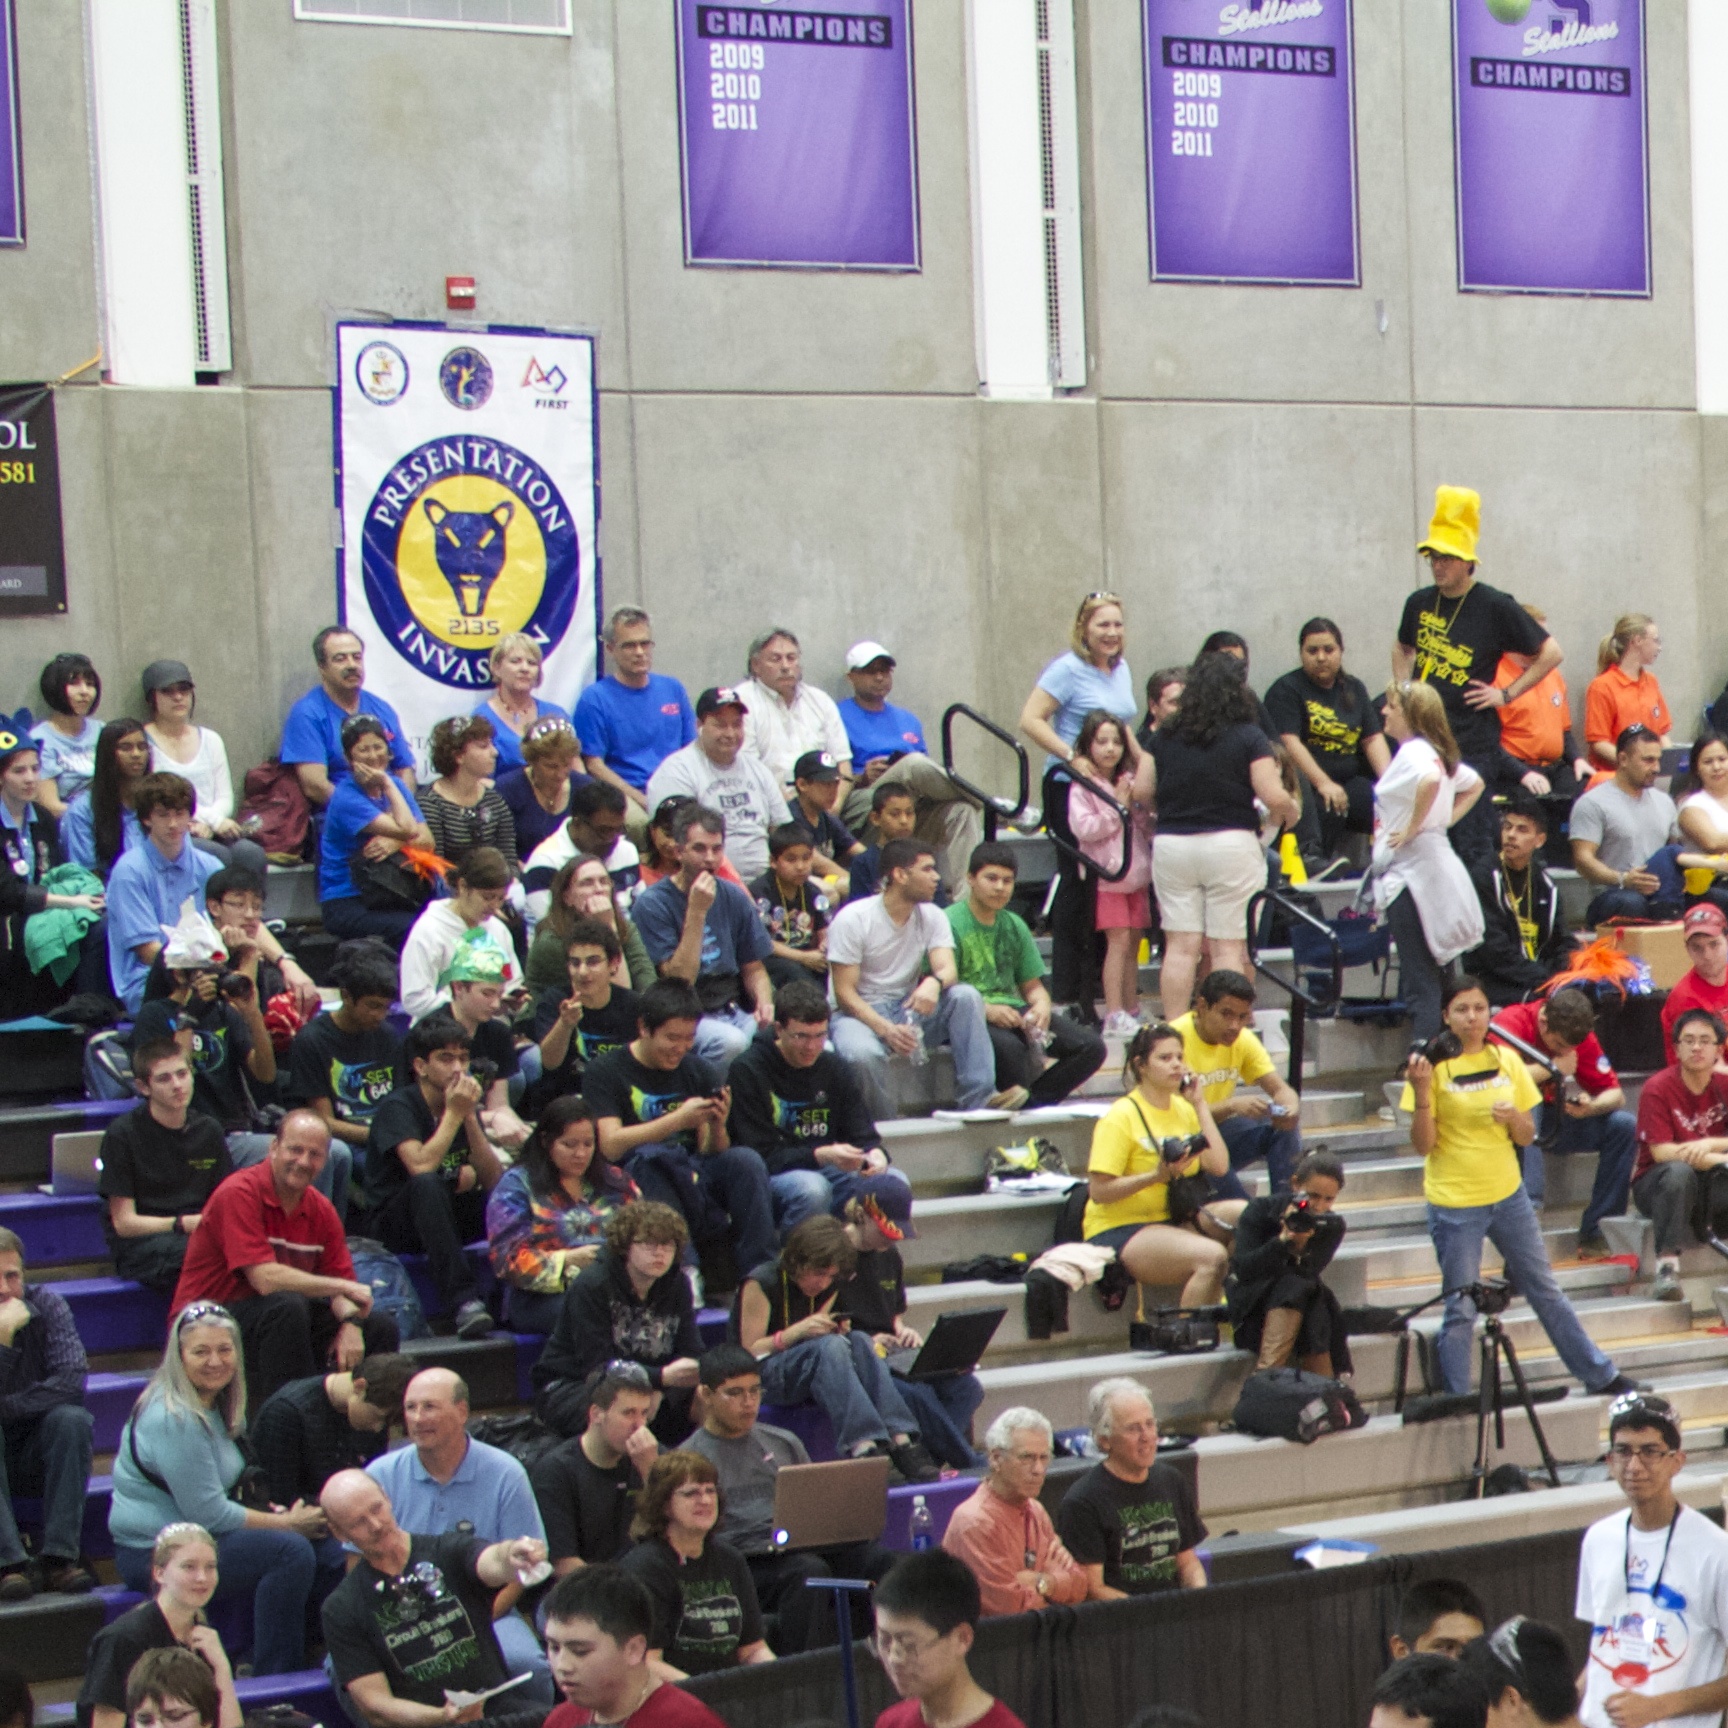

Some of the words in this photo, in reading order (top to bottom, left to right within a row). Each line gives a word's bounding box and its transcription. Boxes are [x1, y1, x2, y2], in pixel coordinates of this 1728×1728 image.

[706, 12, 886, 43] CHAMPIONS
[1523, 20, 1619, 56] Stallions
[709, 43, 765, 70] 2009
[1170, 43, 1331, 73] CHAMPIONS
[711, 73, 761, 100] 2010
[1173, 72, 1222, 98] 2009
[1478, 64, 1626, 92] CHAMPIONS
[712, 104, 758, 130] 2011
[1174, 102, 1219, 128] 2010
[1172, 131, 1213, 157] 2011
[535, 398, 568, 410] FIRST
[373, 441, 567, 532] PRESENTATION
[448, 619, 501, 636] 2135
[397, 620, 551, 685] INVASN
